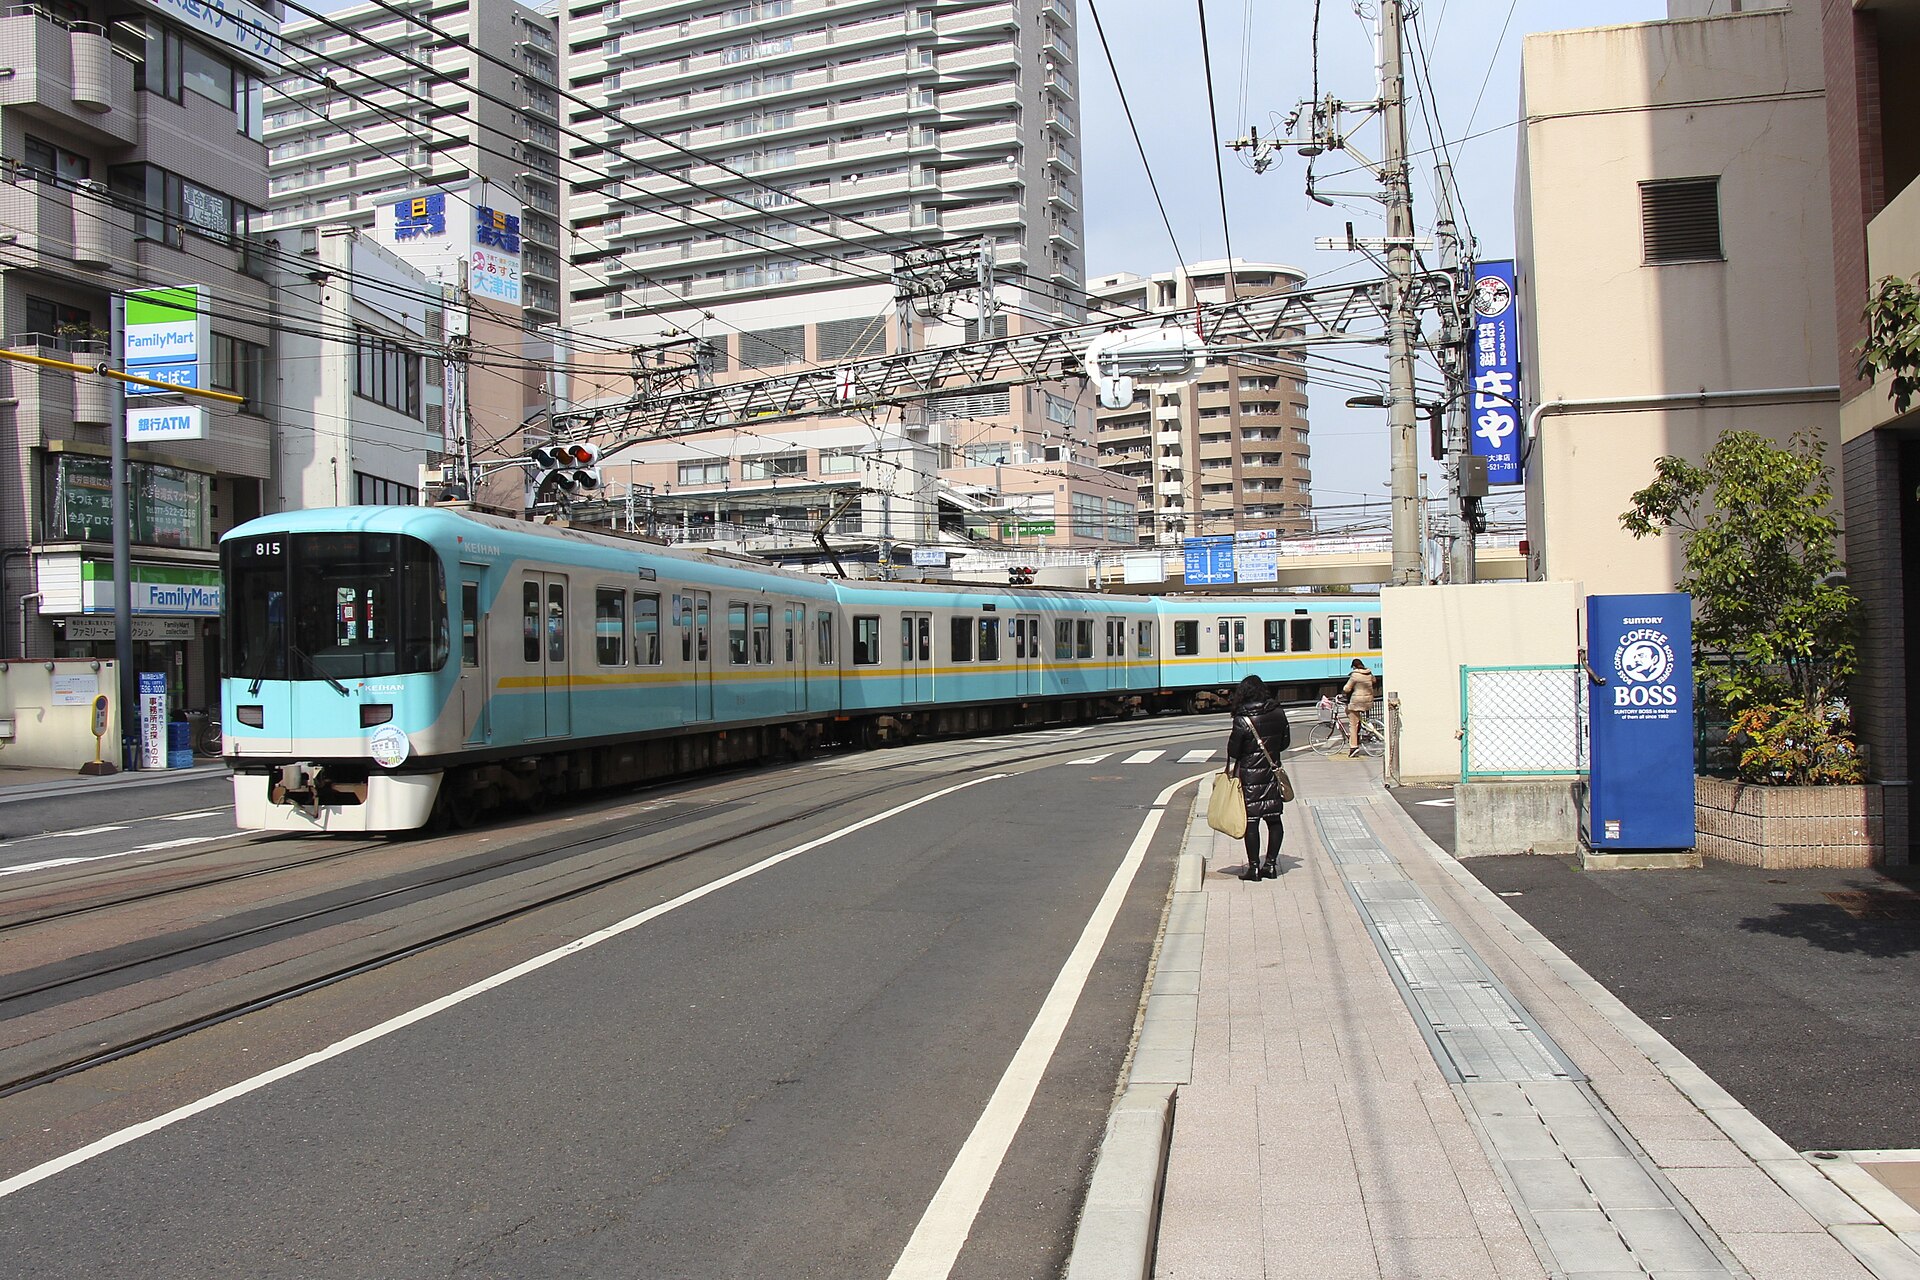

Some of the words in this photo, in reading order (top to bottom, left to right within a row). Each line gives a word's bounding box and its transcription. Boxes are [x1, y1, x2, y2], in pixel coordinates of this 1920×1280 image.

[487, 263, 518, 280] あすと
[474, 272, 518, 299] 大津市
[128, 332, 194, 348] FamilyMart
[156, 370, 191, 385] たばこ
[1474, 370, 1514, 448] 庄や
[138, 416, 190, 431] 銀行ATM
[256, 543, 281, 555] 815
[464, 542, 500, 556] KEIHAN
[150, 586, 220, 611] FamilyMart
[164, 621, 190, 629] FamilyMart
[1620, 629, 1668, 646] COFFEE
[1614, 646, 1625, 670] COFFEE
[1662, 644, 1674, 663] BOSS
[1613, 685, 1677, 706] BOSS
[149, 697, 159, 765] 事務所お探しの方
